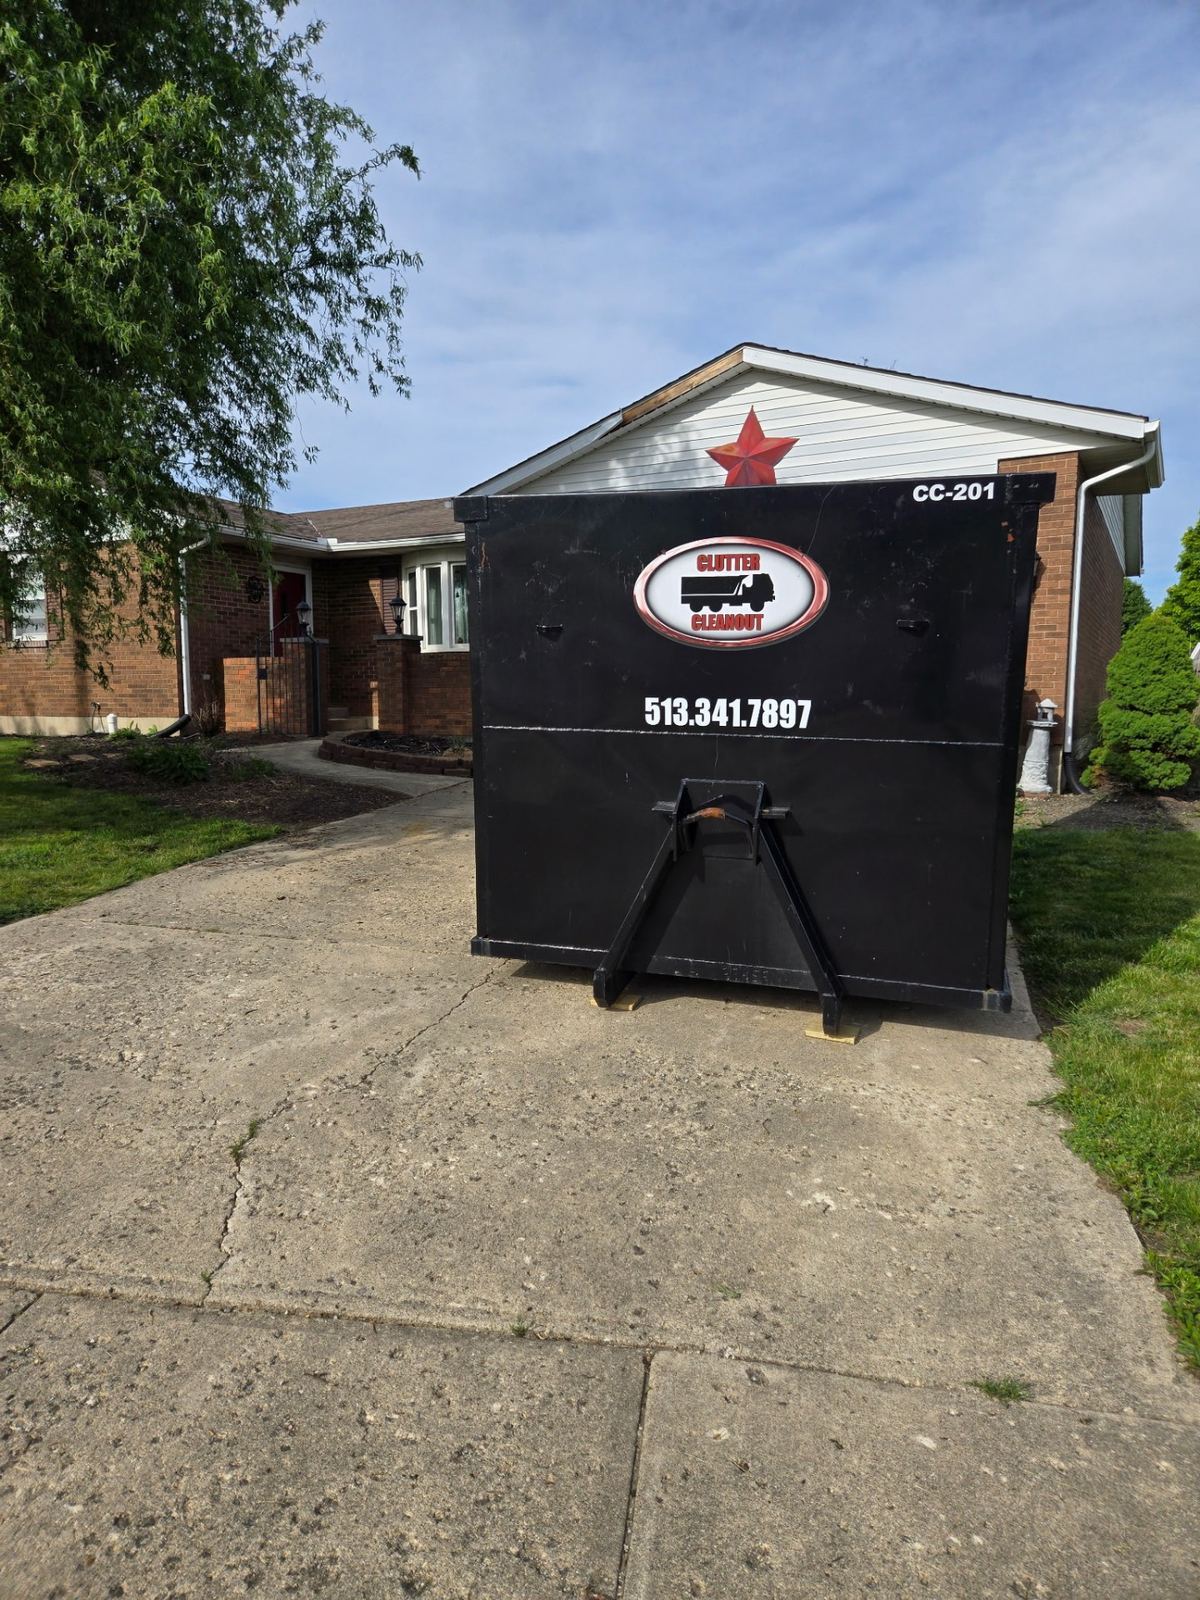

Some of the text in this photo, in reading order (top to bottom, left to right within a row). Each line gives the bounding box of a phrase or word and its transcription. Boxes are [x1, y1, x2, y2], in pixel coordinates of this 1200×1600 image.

[912, 482, 995, 502] CC-201
[697, 554, 760, 571] CLUTTER
[691, 614, 763, 631] CLEANOUT
[644, 697, 812, 729] 513.341.7897
